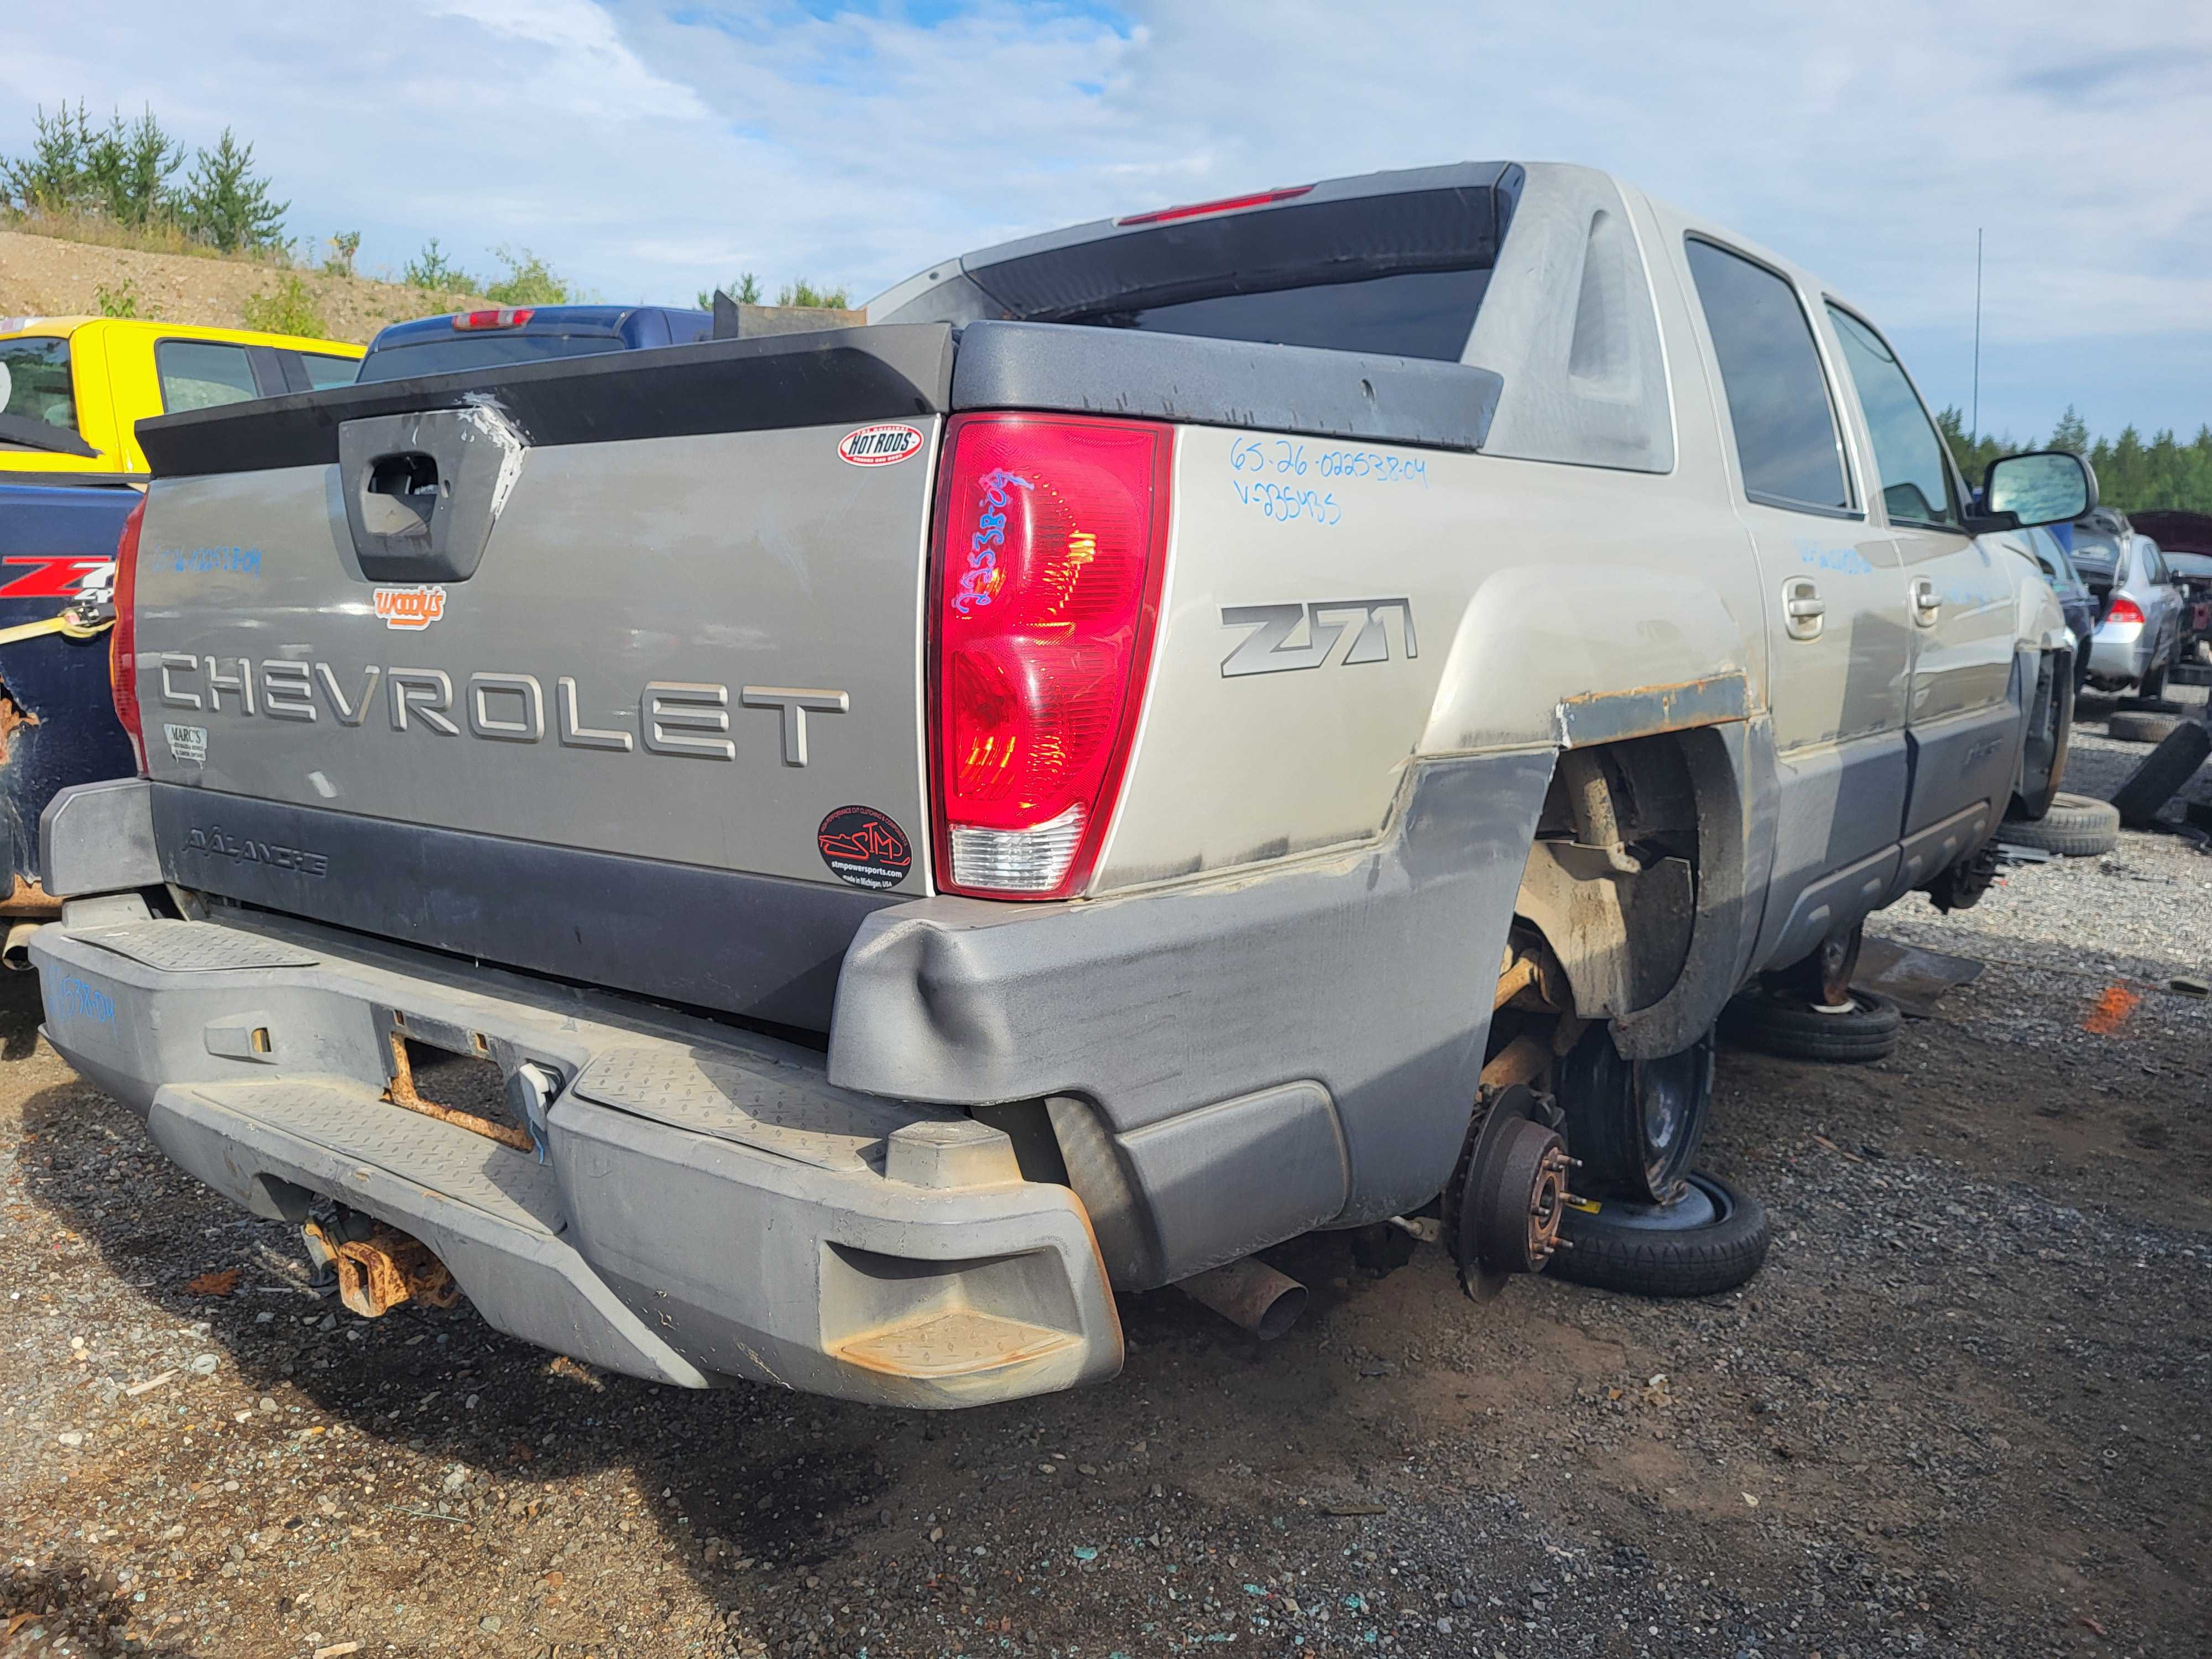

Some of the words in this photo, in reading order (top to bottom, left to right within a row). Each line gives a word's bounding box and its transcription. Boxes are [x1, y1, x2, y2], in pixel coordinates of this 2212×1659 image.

[848, 434, 877, 455] HOT
[874, 432, 912, 453] RODS
[1220, 597, 1418, 679] Z71
[160, 651, 850, 769] CHEVROLET
[171, 727, 201, 744] MARC'S
[831, 860, 902, 878] stmpowersports.com
[842, 874, 855, 883] made
[855, 875, 860, 884] in
